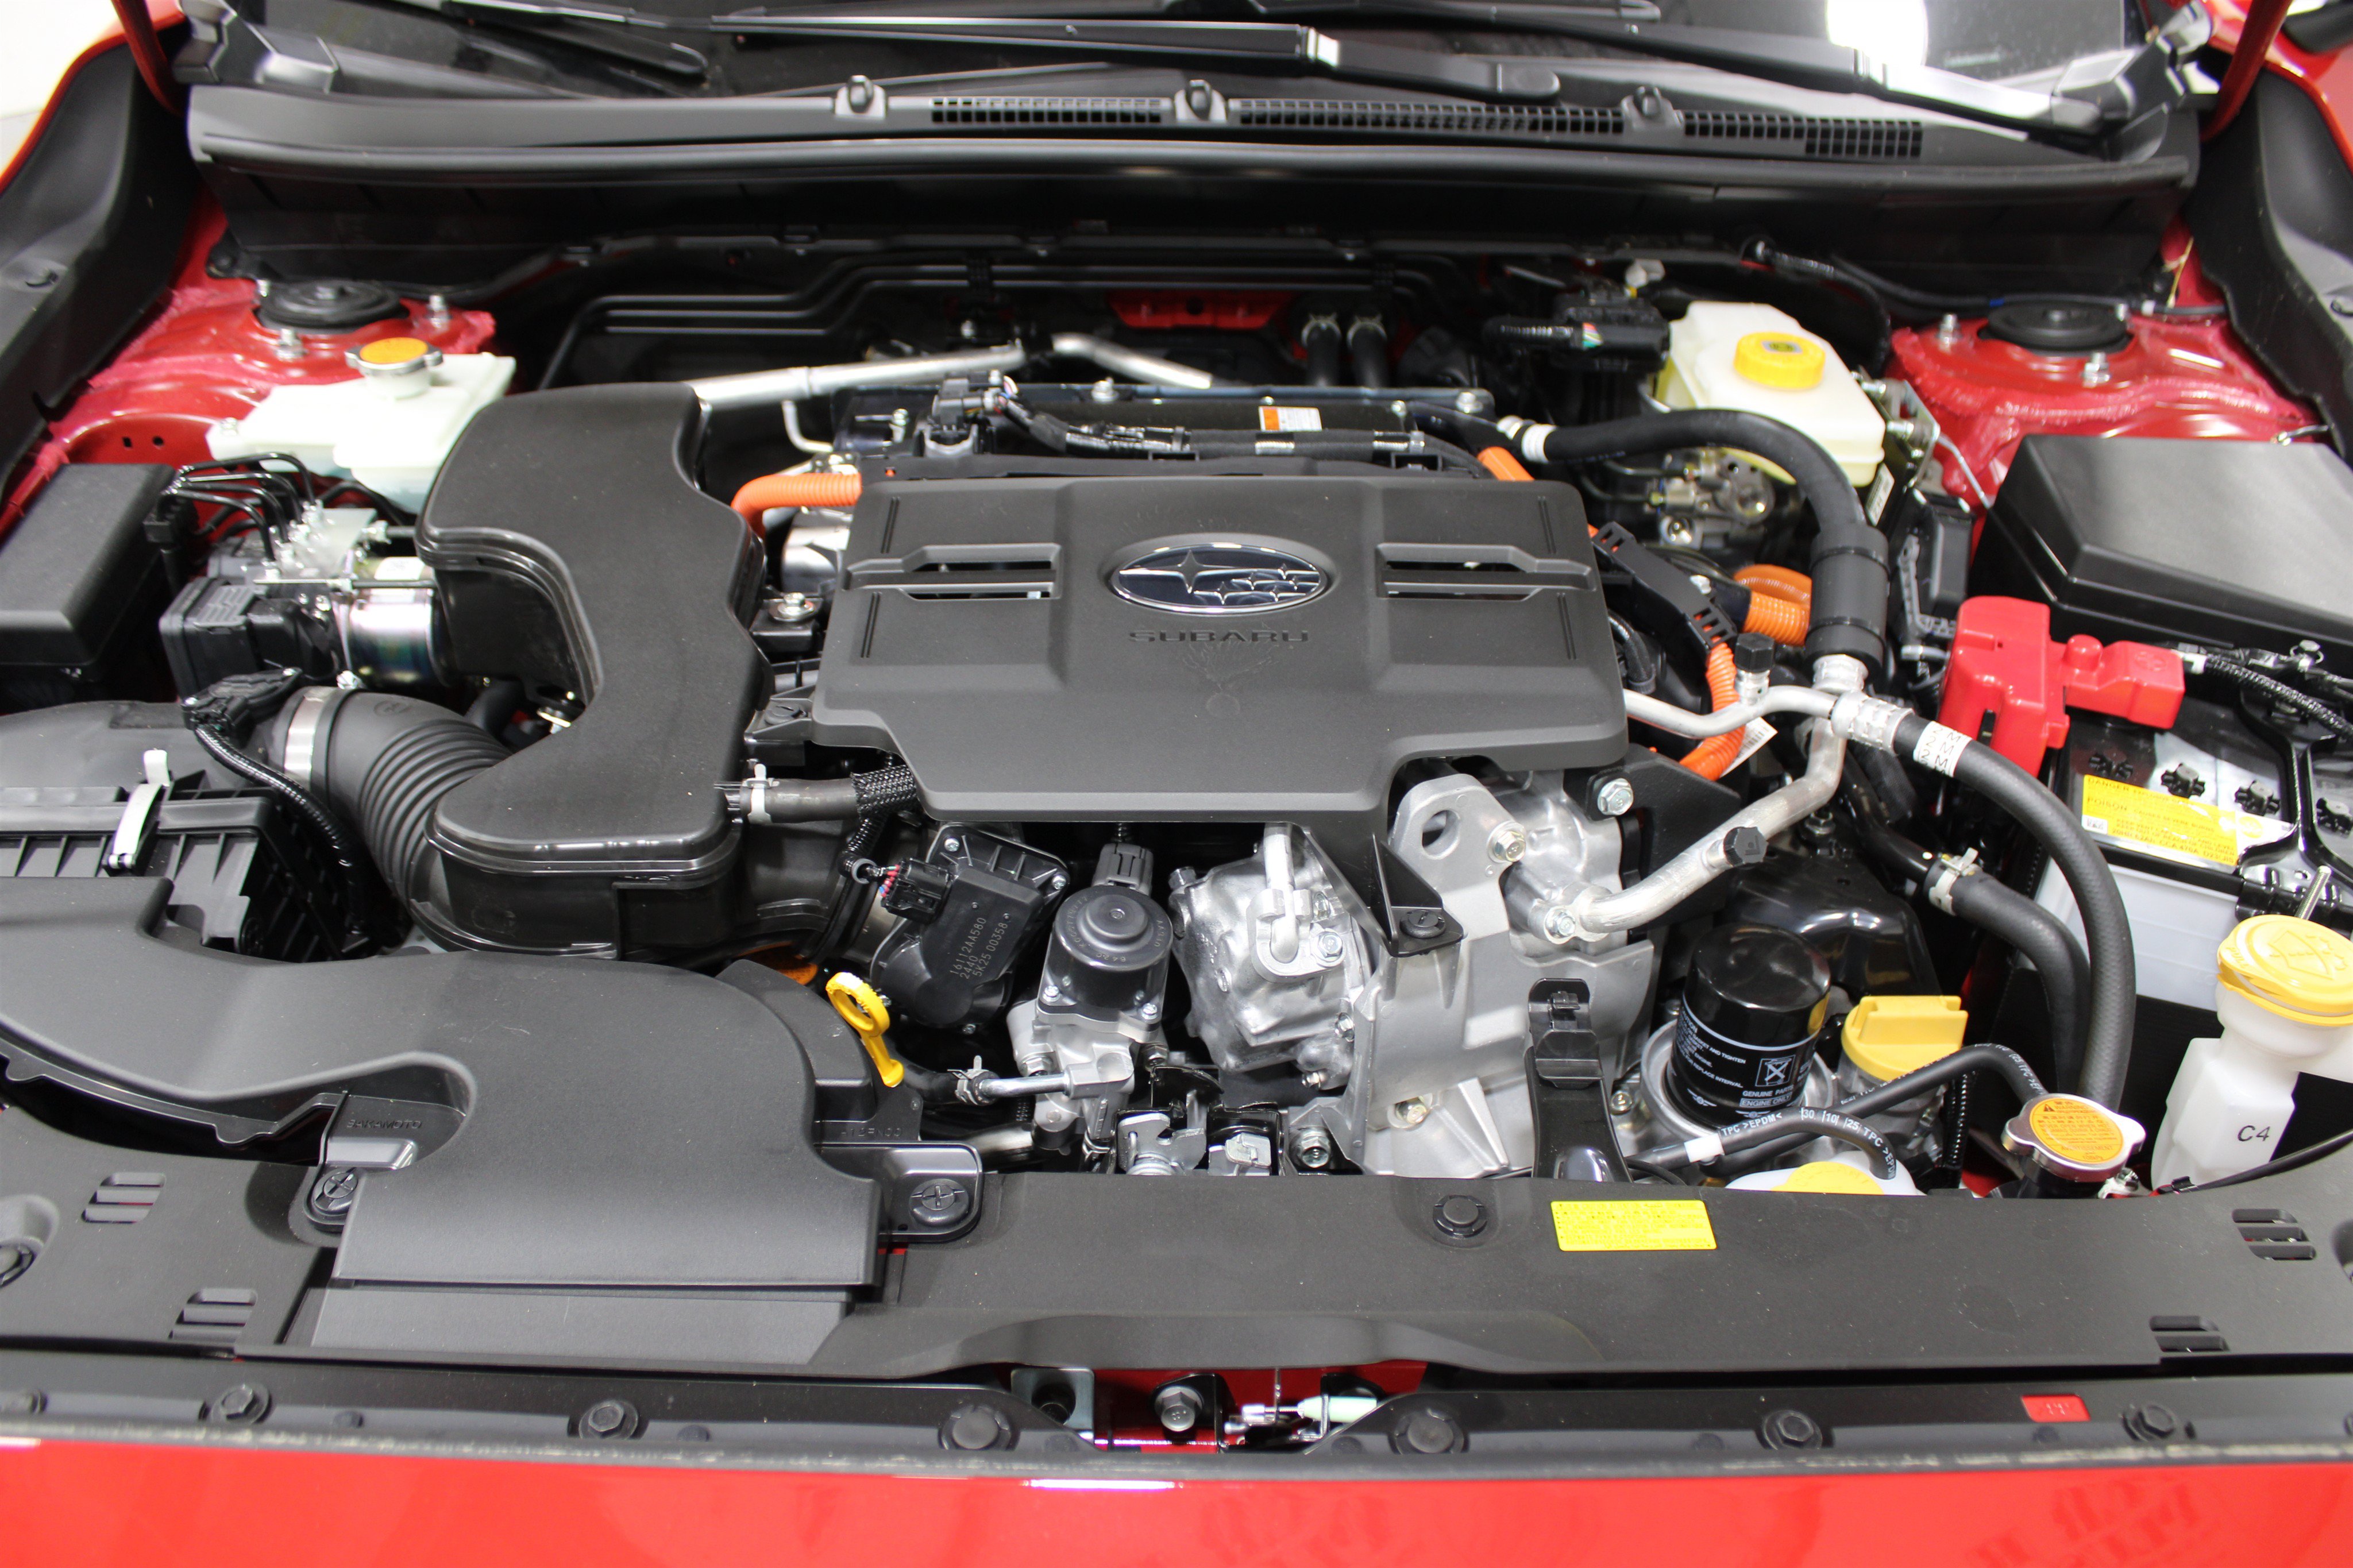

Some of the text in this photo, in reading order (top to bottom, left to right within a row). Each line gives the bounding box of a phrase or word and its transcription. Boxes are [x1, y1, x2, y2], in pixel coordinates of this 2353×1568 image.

[1129, 630, 1309, 642] SUBARU
[1939, 741, 1955, 756] M
[1934, 754, 1949, 769] M
[2088, 778, 2130, 791] DANGER
[2087, 797, 2128, 812] POISON
[949, 917, 986, 975] 16112AA580
[972, 922, 1008, 977] 5K25 00358
[959, 955, 978, 979] 2440
[1721, 1052, 1746, 1064] TIGHTEN
[1775, 1084, 1794, 1096] PARTS
[1772, 1094, 1791, 1104] ONLY
[346, 1119, 423, 1129] SAKAMOTO
[1721, 1125, 1740, 1136] TPC
[1742, 1112, 1783, 1129] >EPDM<
[1863, 1126, 1883, 1147] TPC
[2238, 1125, 2271, 1142] C4
